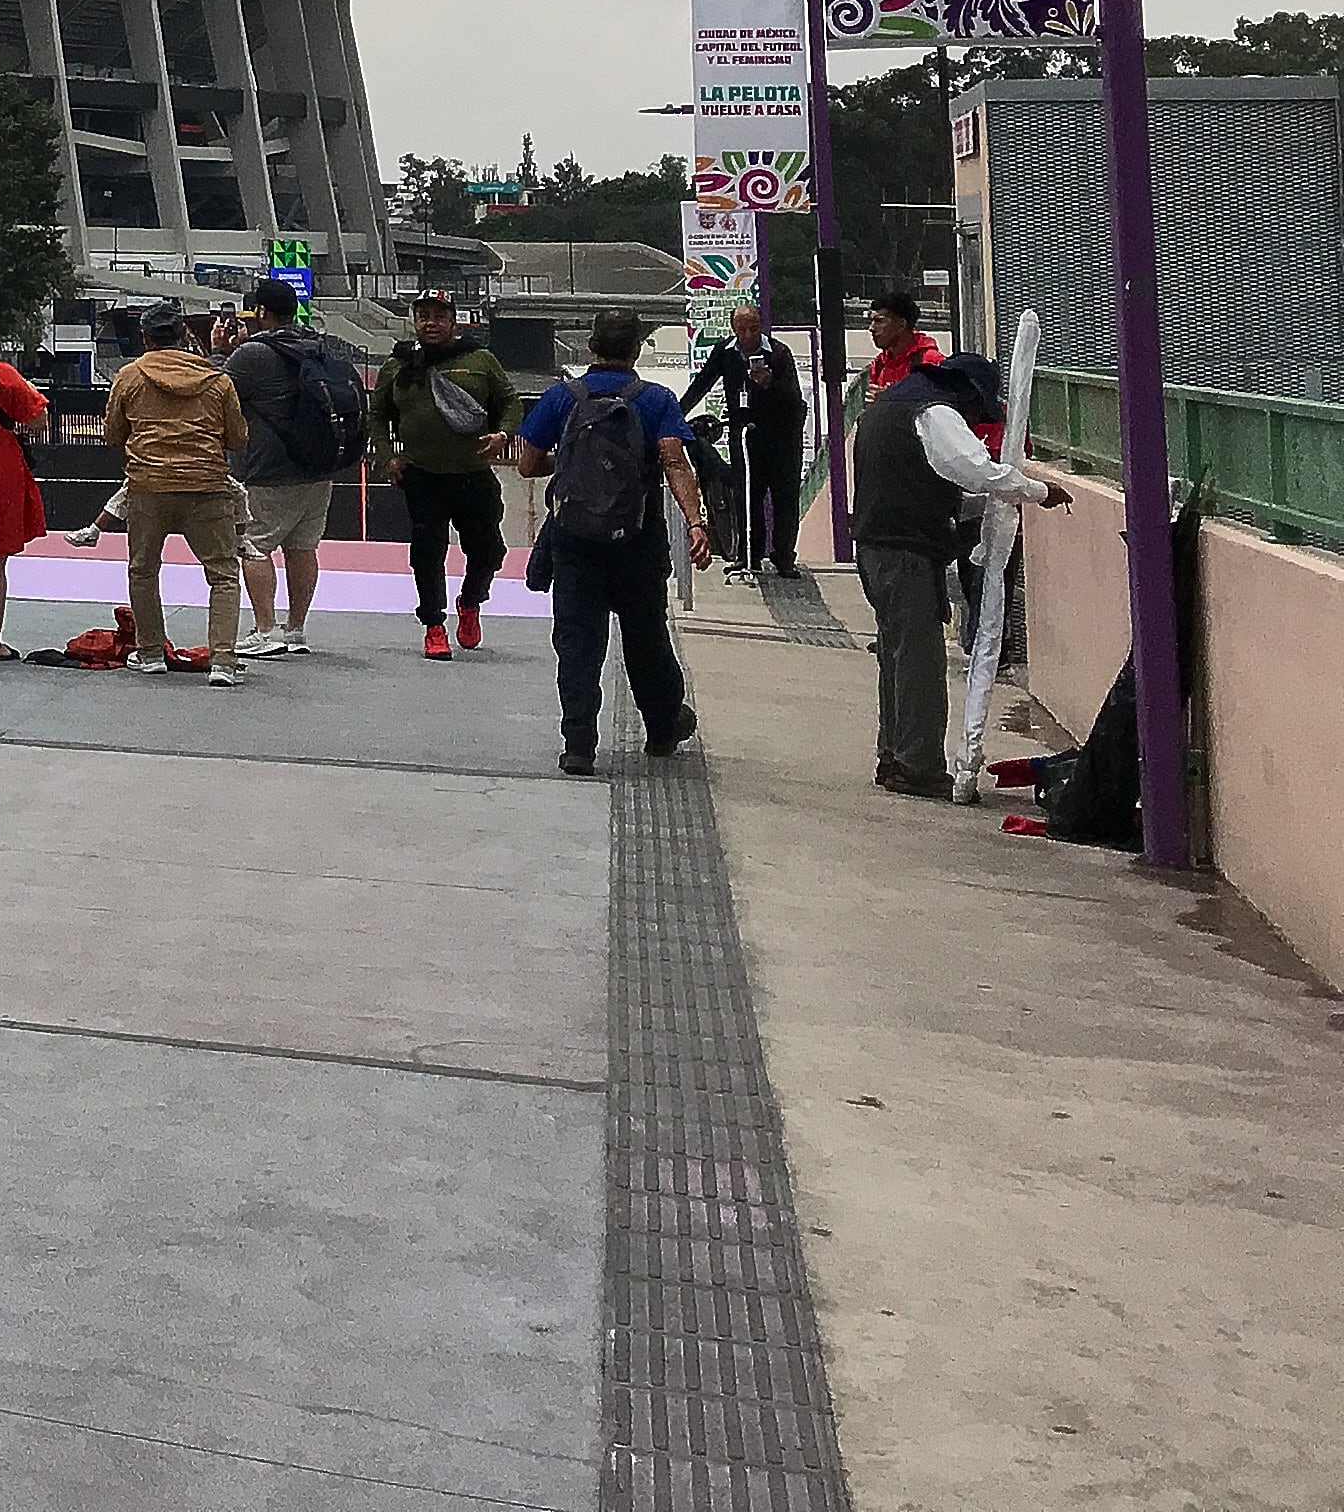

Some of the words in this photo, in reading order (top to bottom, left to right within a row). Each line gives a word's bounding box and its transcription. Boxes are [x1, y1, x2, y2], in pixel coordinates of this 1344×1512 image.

[698, 29, 737, 39] CIUDAD
[740, 29, 753, 38] DE
[695, 43, 739, 52] CAPITAL
[741, 43, 760, 51] DEL
[707, 56, 715, 64] Y
[717, 56, 730, 64] EL
[732, 55, 792, 65] FEMINISMO
[700, 86, 724, 101] LA
[728, 86, 801, 101] PELOTA
[700, 104, 751, 115] VUELVE
[754, 105, 764, 115] A
[767, 104, 801, 115] CASA
[656, 356, 687, 364] TACOS
